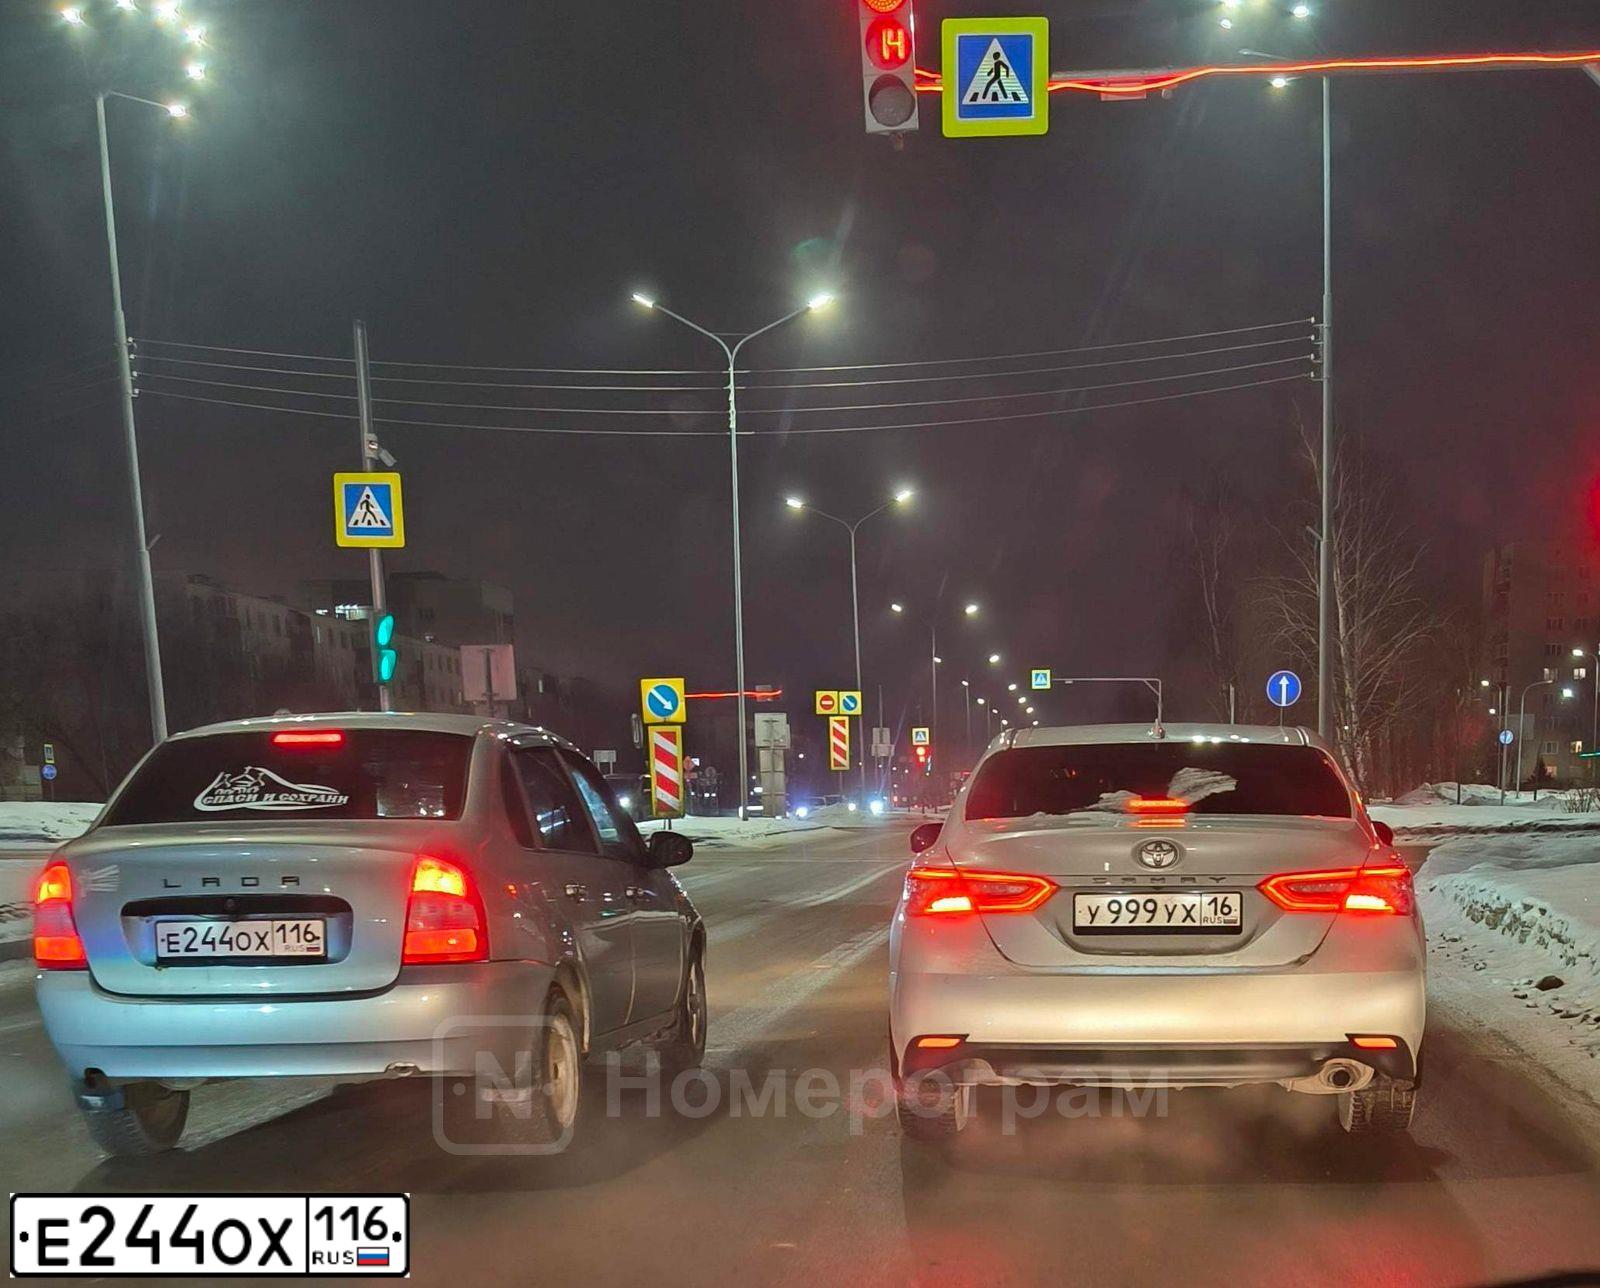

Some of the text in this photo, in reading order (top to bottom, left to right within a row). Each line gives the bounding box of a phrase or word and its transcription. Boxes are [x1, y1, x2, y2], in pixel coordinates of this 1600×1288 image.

[882, 28, 905, 60] 14
[203, 792, 350, 805] СПАСИ И СОХРАНИ
[163, 876, 300, 888] LADA
[1207, 896, 1232, 916] 16
[1203, 916, 1222, 924] RUS
[276, 923, 317, 944] 116
